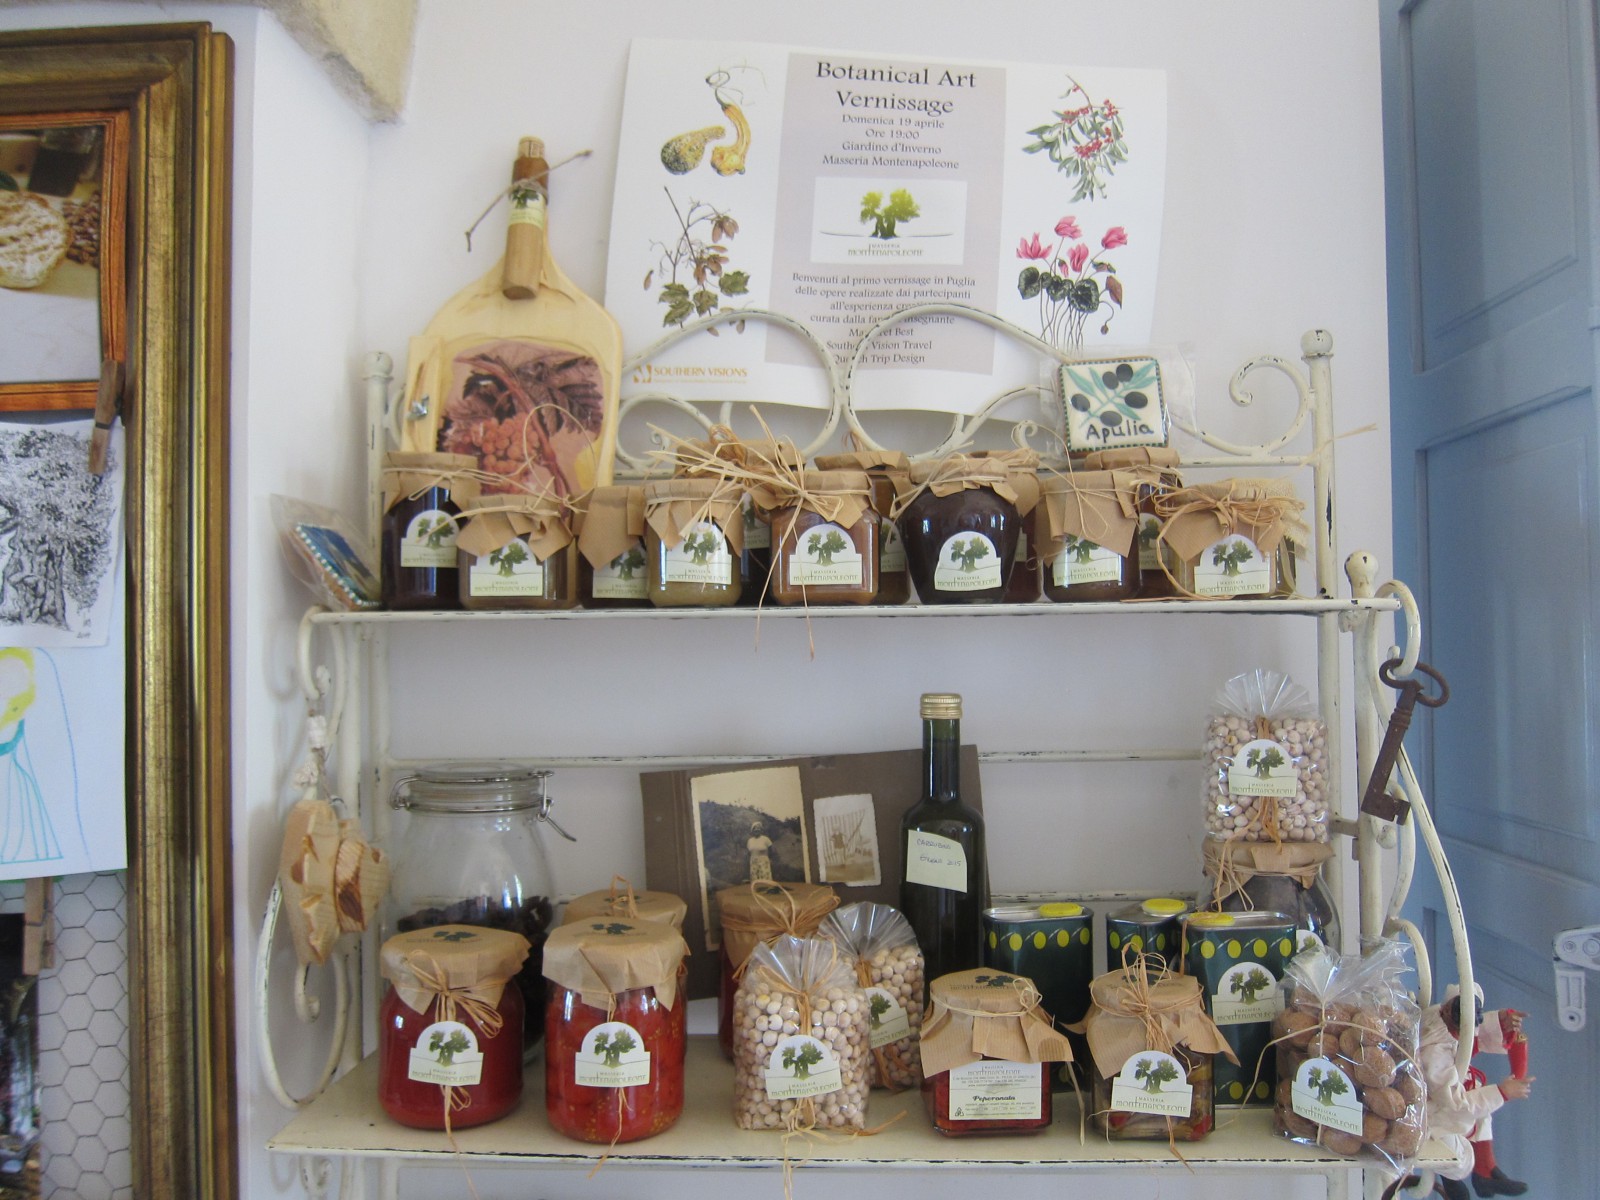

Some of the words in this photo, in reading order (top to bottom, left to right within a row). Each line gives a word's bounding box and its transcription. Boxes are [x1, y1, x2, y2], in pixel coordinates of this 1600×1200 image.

[816, 61, 929, 85] Botanical
[937, 70, 977, 88] Art
[836, 90, 954, 117] Vernissage
[842, 114, 894, 125] Domenica
[899, 117, 912, 126] 19
[914, 118, 945, 130] aprile
[865, 128, 886, 138] Ore
[890, 130, 920, 140] 19:00
[842, 141, 889, 152] Giardino
[891, 142, 942, 154] d'Inverno
[822, 155, 869, 166] Masseria
[871, 156, 960, 169] Montenapoleone
[792, 272, 838, 284] Benvenuti
[841, 275, 850, 284] al
[852, 277, 881, 287] primo
[883, 277, 931, 289] vernissage
[934, 276, 944, 285] in
[946, 276, 976, 289] Puglia
[795, 286, 817, 295] delle
[820, 289, 847, 299] opere
[850, 287, 894, 298] realizzate
[896, 288, 911, 298] dai
[913, 288, 971, 300] partecipanti
[830, 301, 893, 313] all'esperienza
[810, 314, 841, 324] curata
[843, 314, 867, 324] dalla
[894, 327, 914, 336] Best
[871, 341, 901, 350] Vision
[902, 340, 932, 350] Travel
[870, 354, 891, 365] Trip
[893, 354, 925, 365] Design
[654, 366, 705, 376] SOUTHERN
[708, 366, 748, 377] VISIONS
[1086, 420, 1154, 443] Apulia
